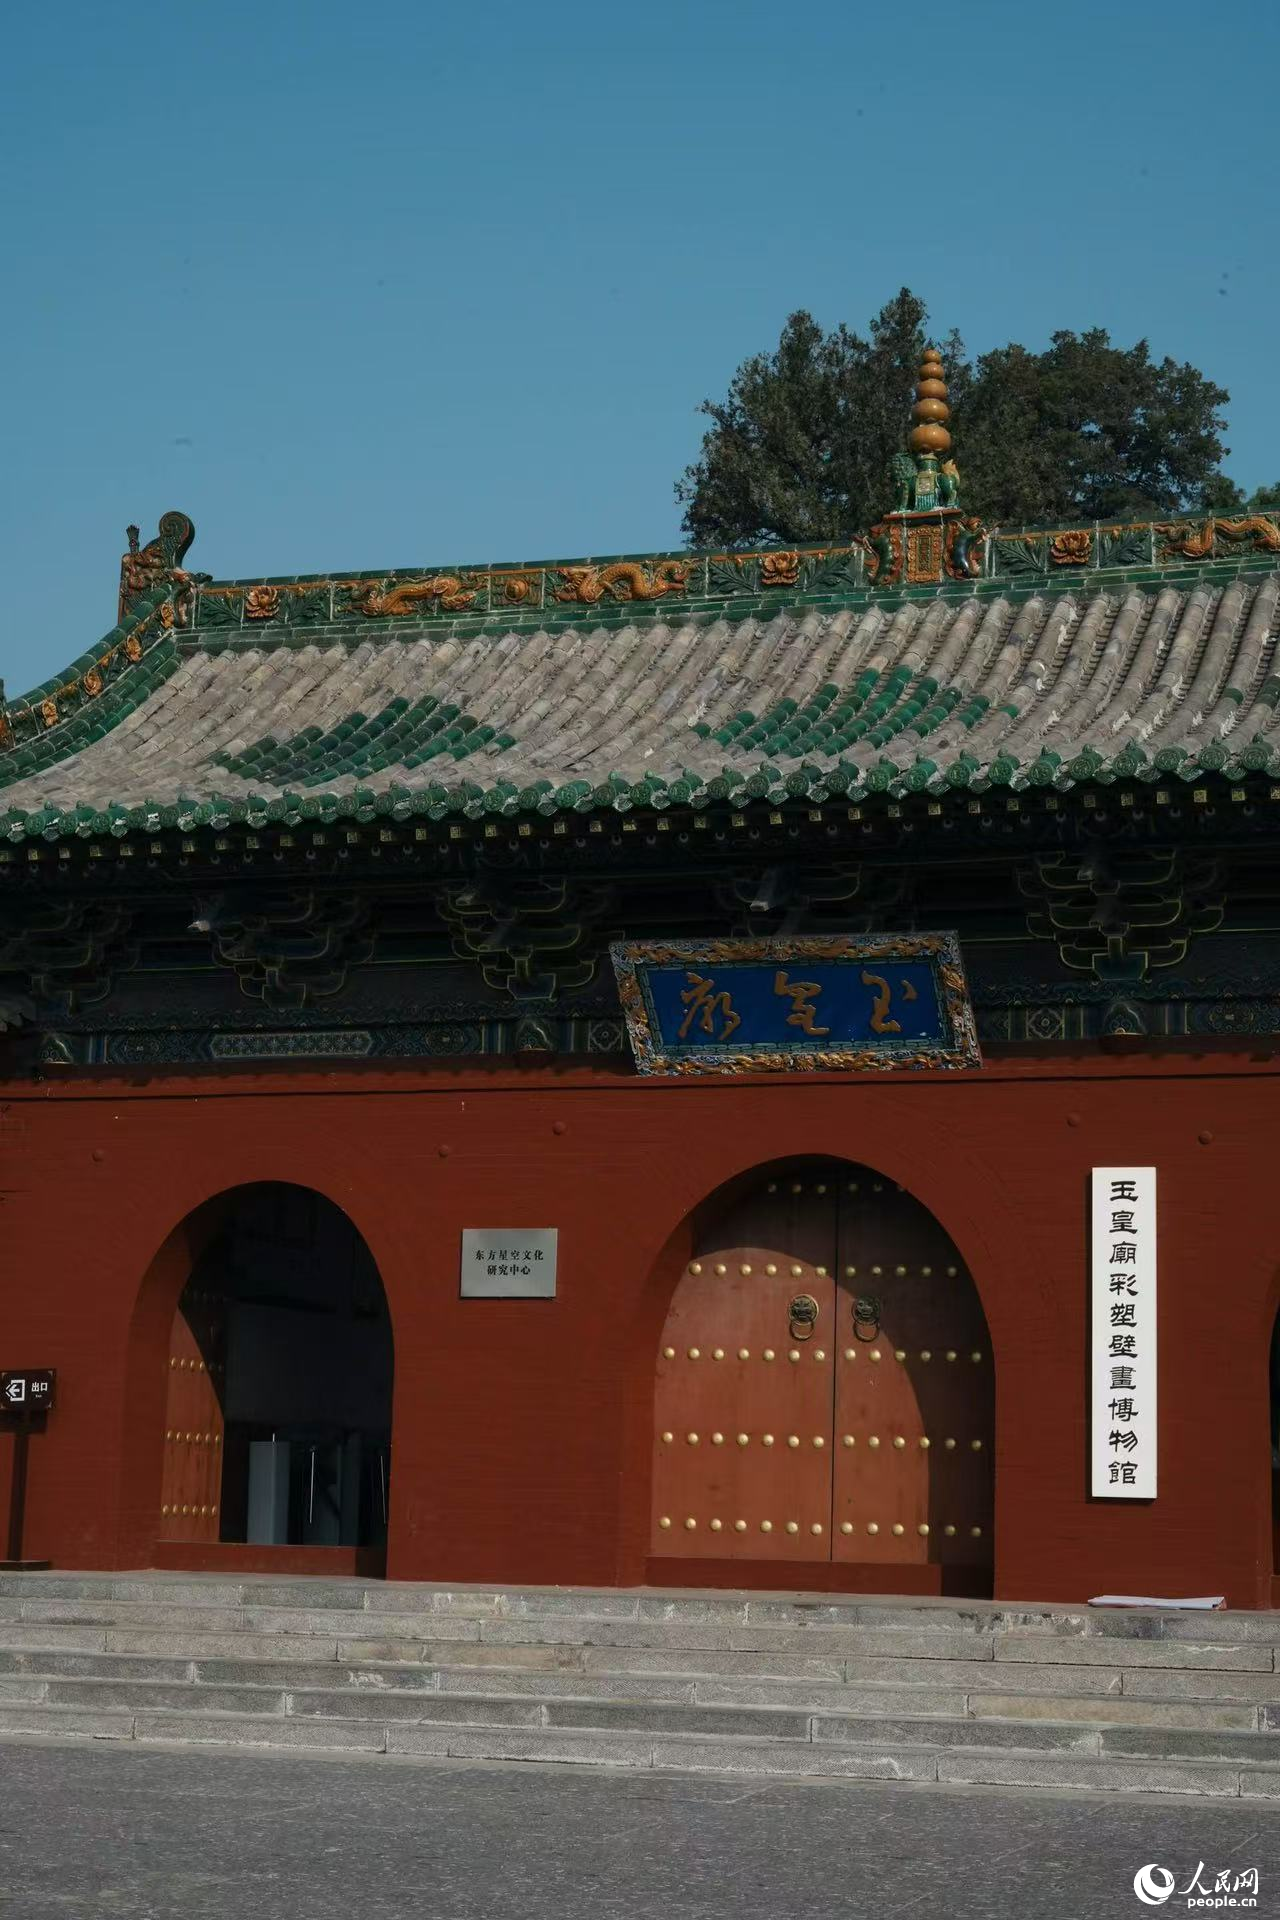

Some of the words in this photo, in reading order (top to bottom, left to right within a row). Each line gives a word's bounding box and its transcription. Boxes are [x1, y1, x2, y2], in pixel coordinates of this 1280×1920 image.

[475, 1249, 544, 1261] 东方星空文化
[487, 1264, 531, 1275] 研究中心
[1108, 1180, 1139, 1484] 玉皇廟彩塑壁畫博物館
[31, 1381, 48, 1392] 出口
